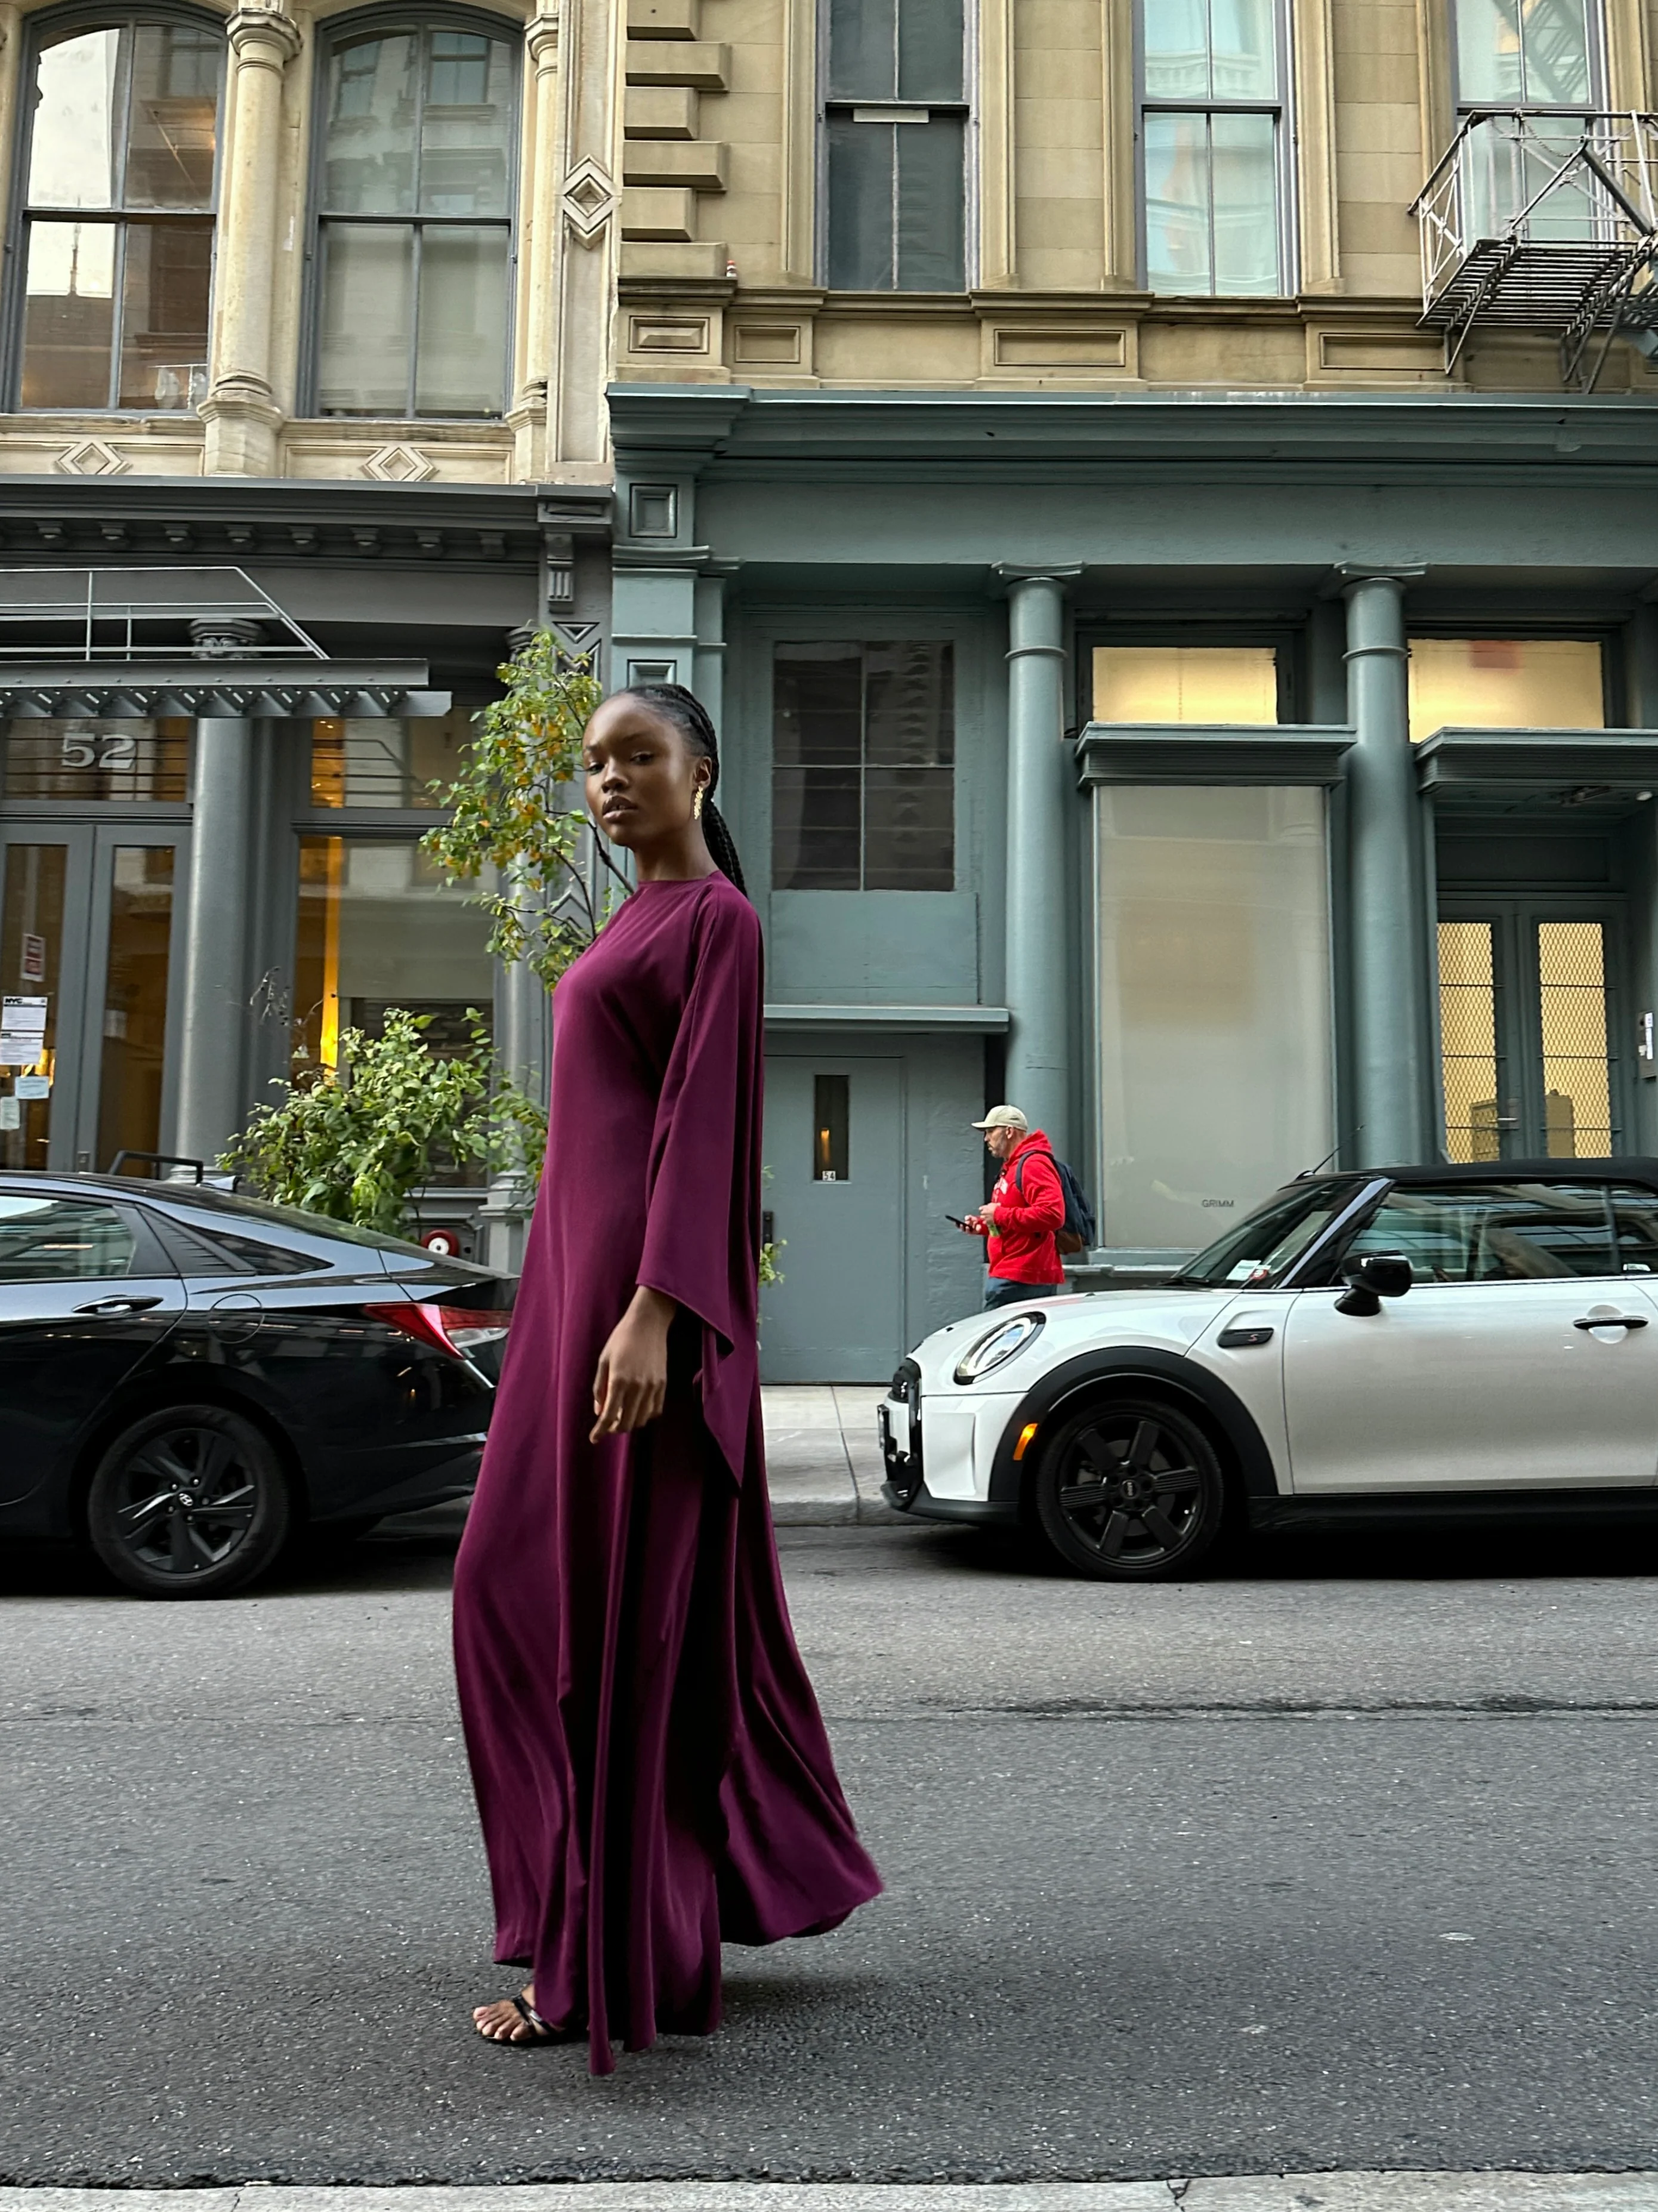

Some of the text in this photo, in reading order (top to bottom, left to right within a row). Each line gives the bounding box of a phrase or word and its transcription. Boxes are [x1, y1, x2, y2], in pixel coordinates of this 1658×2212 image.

[61, 733, 135, 769] 52
[824, 1172, 834, 1180] 54
[1202, 1199, 1234, 1208] GRIMM
[1248, 1334, 1259, 1342] S
